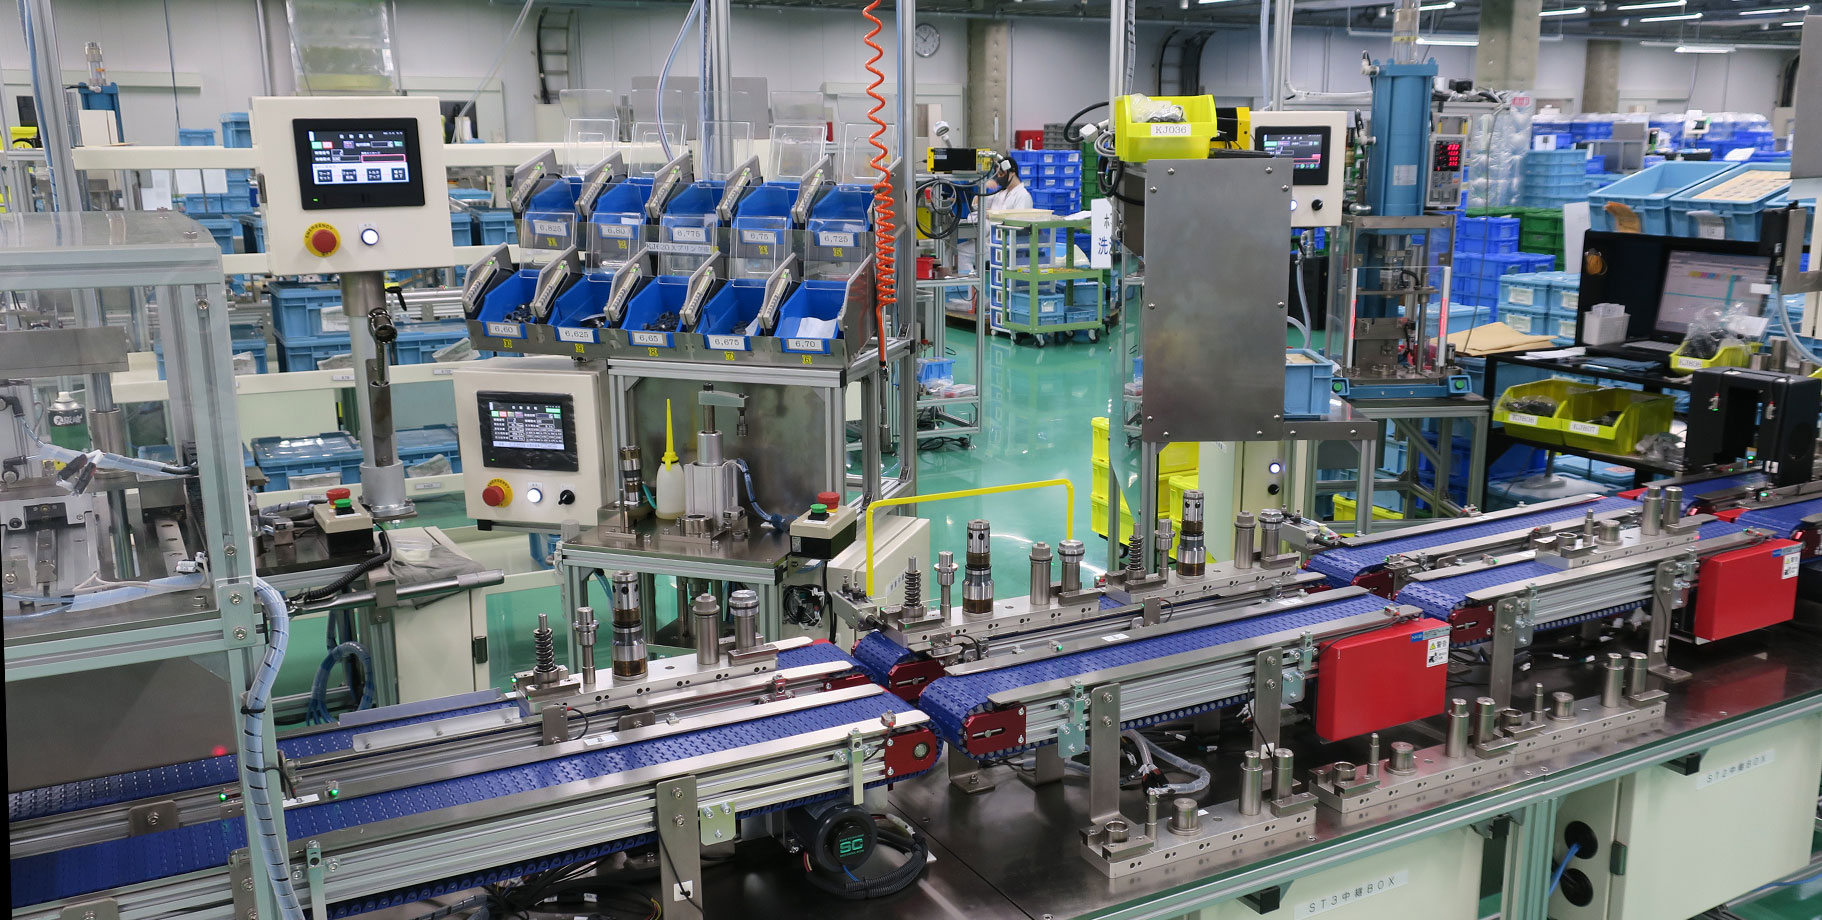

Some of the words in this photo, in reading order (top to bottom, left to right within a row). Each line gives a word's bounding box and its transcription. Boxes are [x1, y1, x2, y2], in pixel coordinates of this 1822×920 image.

[1155, 126, 1187, 134] KJ036
[304, 223, 333, 239] EMERGENCY
[839, 837, 864, 854] SC
